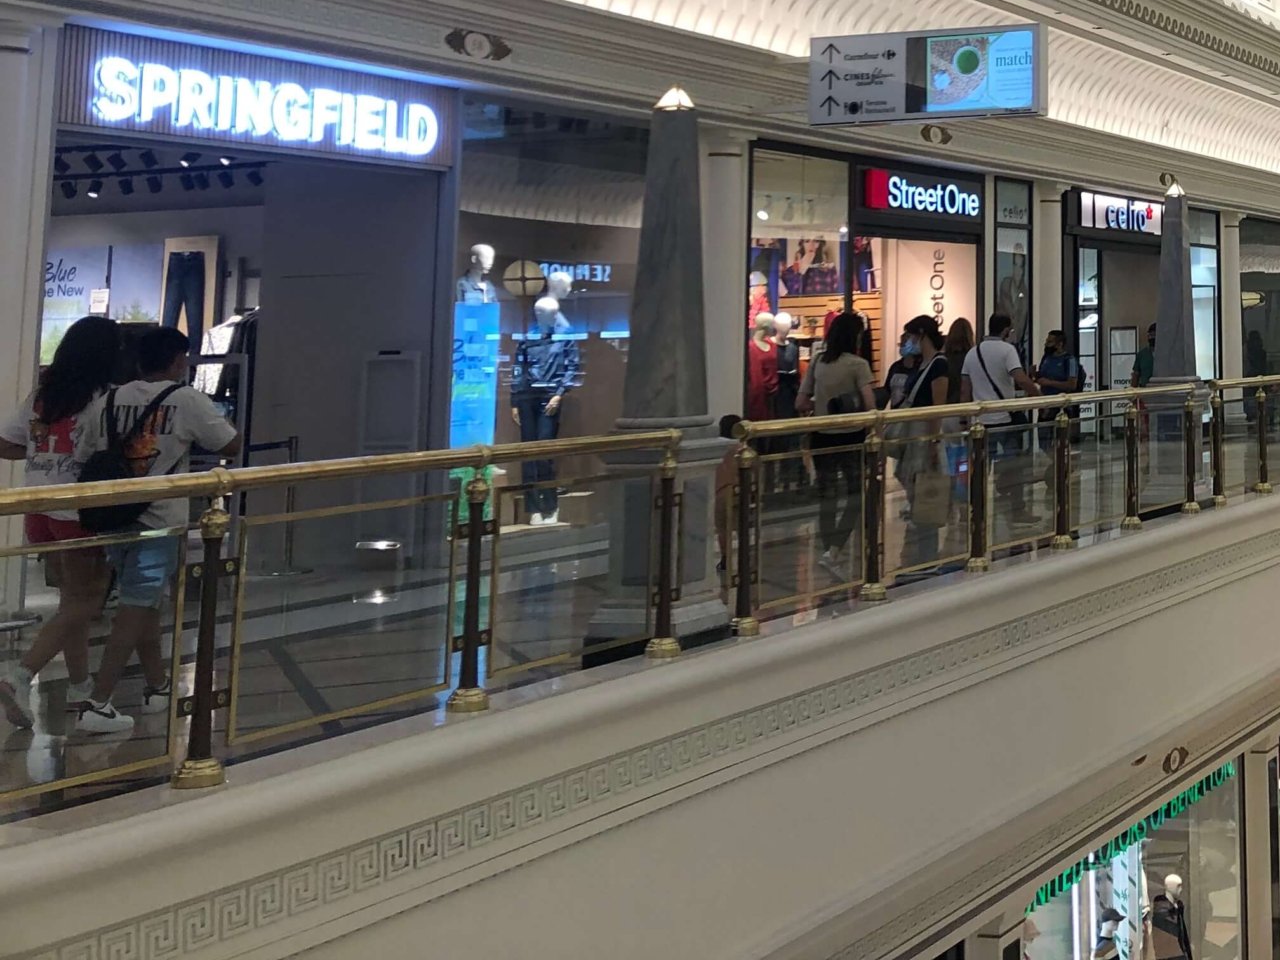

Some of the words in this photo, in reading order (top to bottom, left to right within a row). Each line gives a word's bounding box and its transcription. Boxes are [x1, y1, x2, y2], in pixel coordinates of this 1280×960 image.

[843, 72, 871, 81] CINES
[93, 56, 438, 156] SPRINGFIELD
[930, 249, 945, 291] One
[57, 284, 84, 297] New
